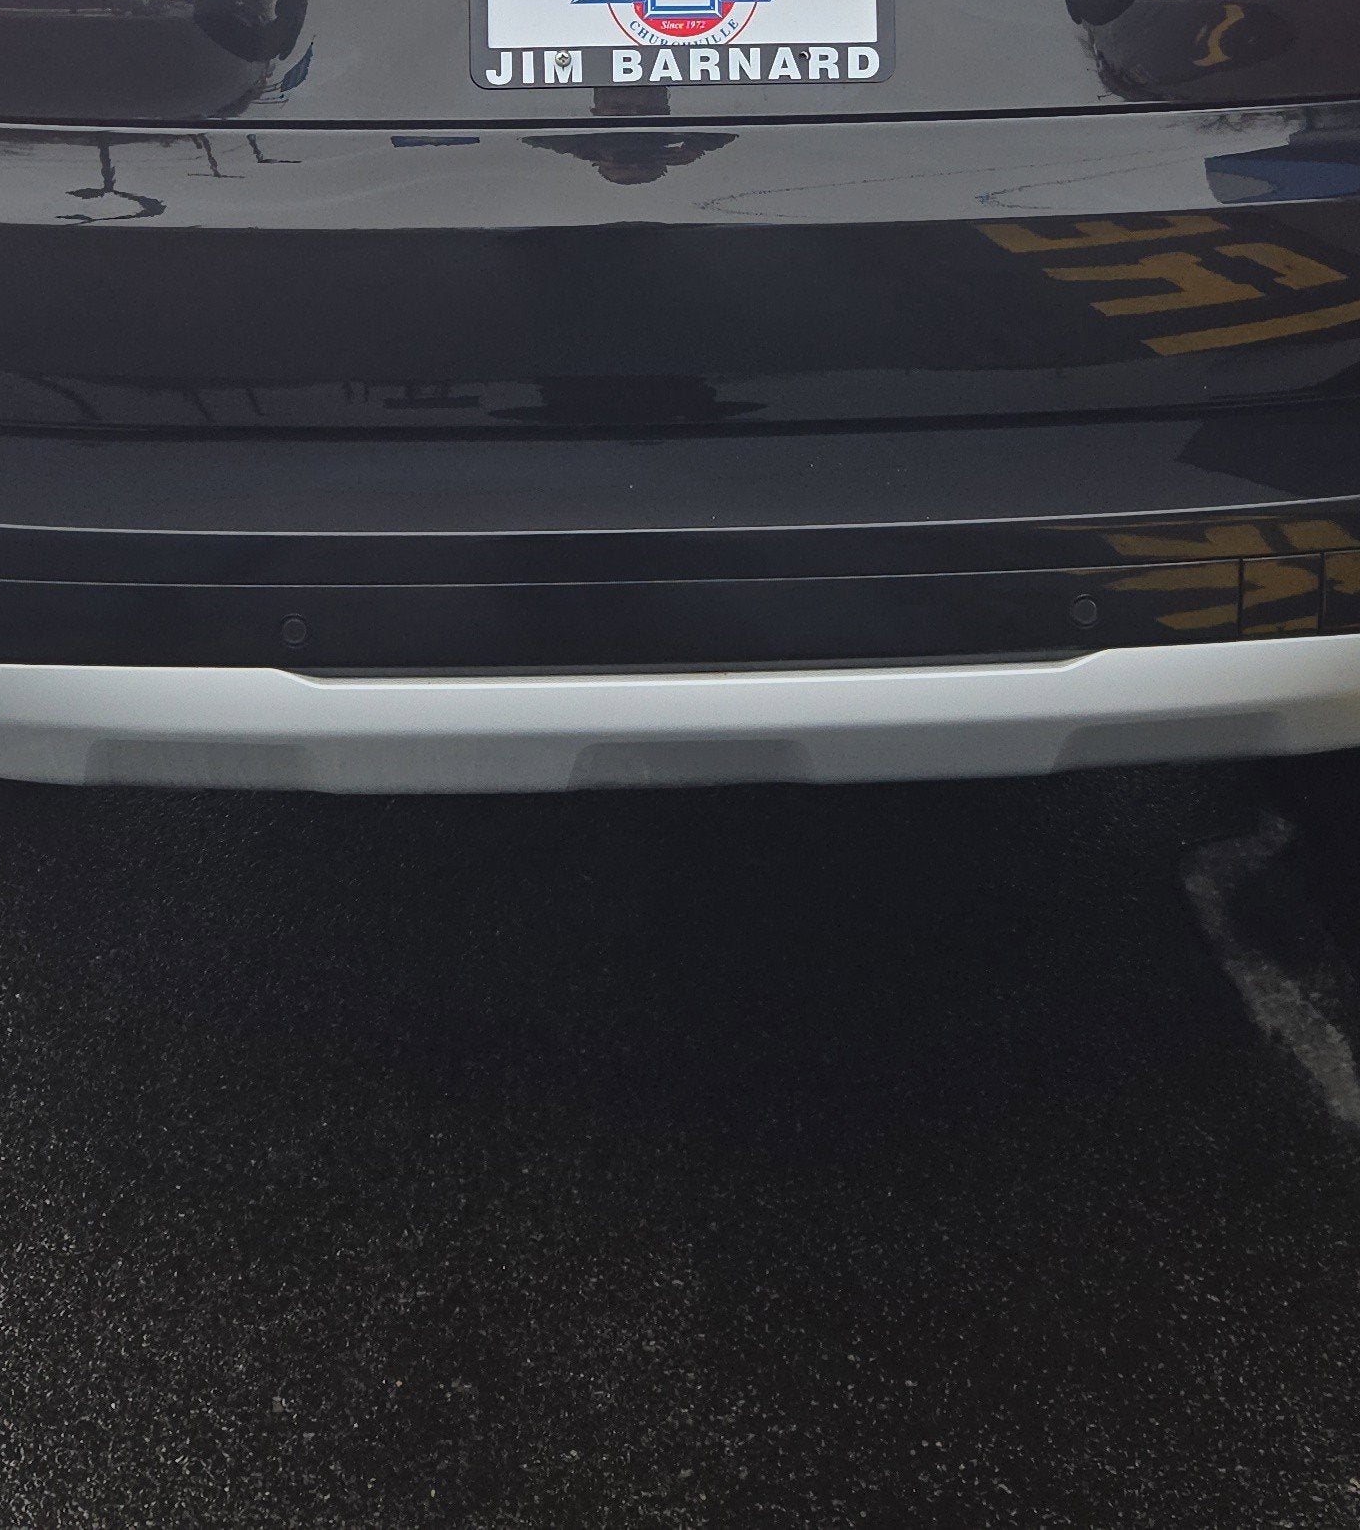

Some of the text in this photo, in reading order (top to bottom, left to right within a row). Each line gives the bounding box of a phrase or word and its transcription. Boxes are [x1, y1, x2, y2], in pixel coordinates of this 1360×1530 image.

[660, 20, 707, 30] Since 1972
[485, 47, 881, 86] JIM BARNARD
